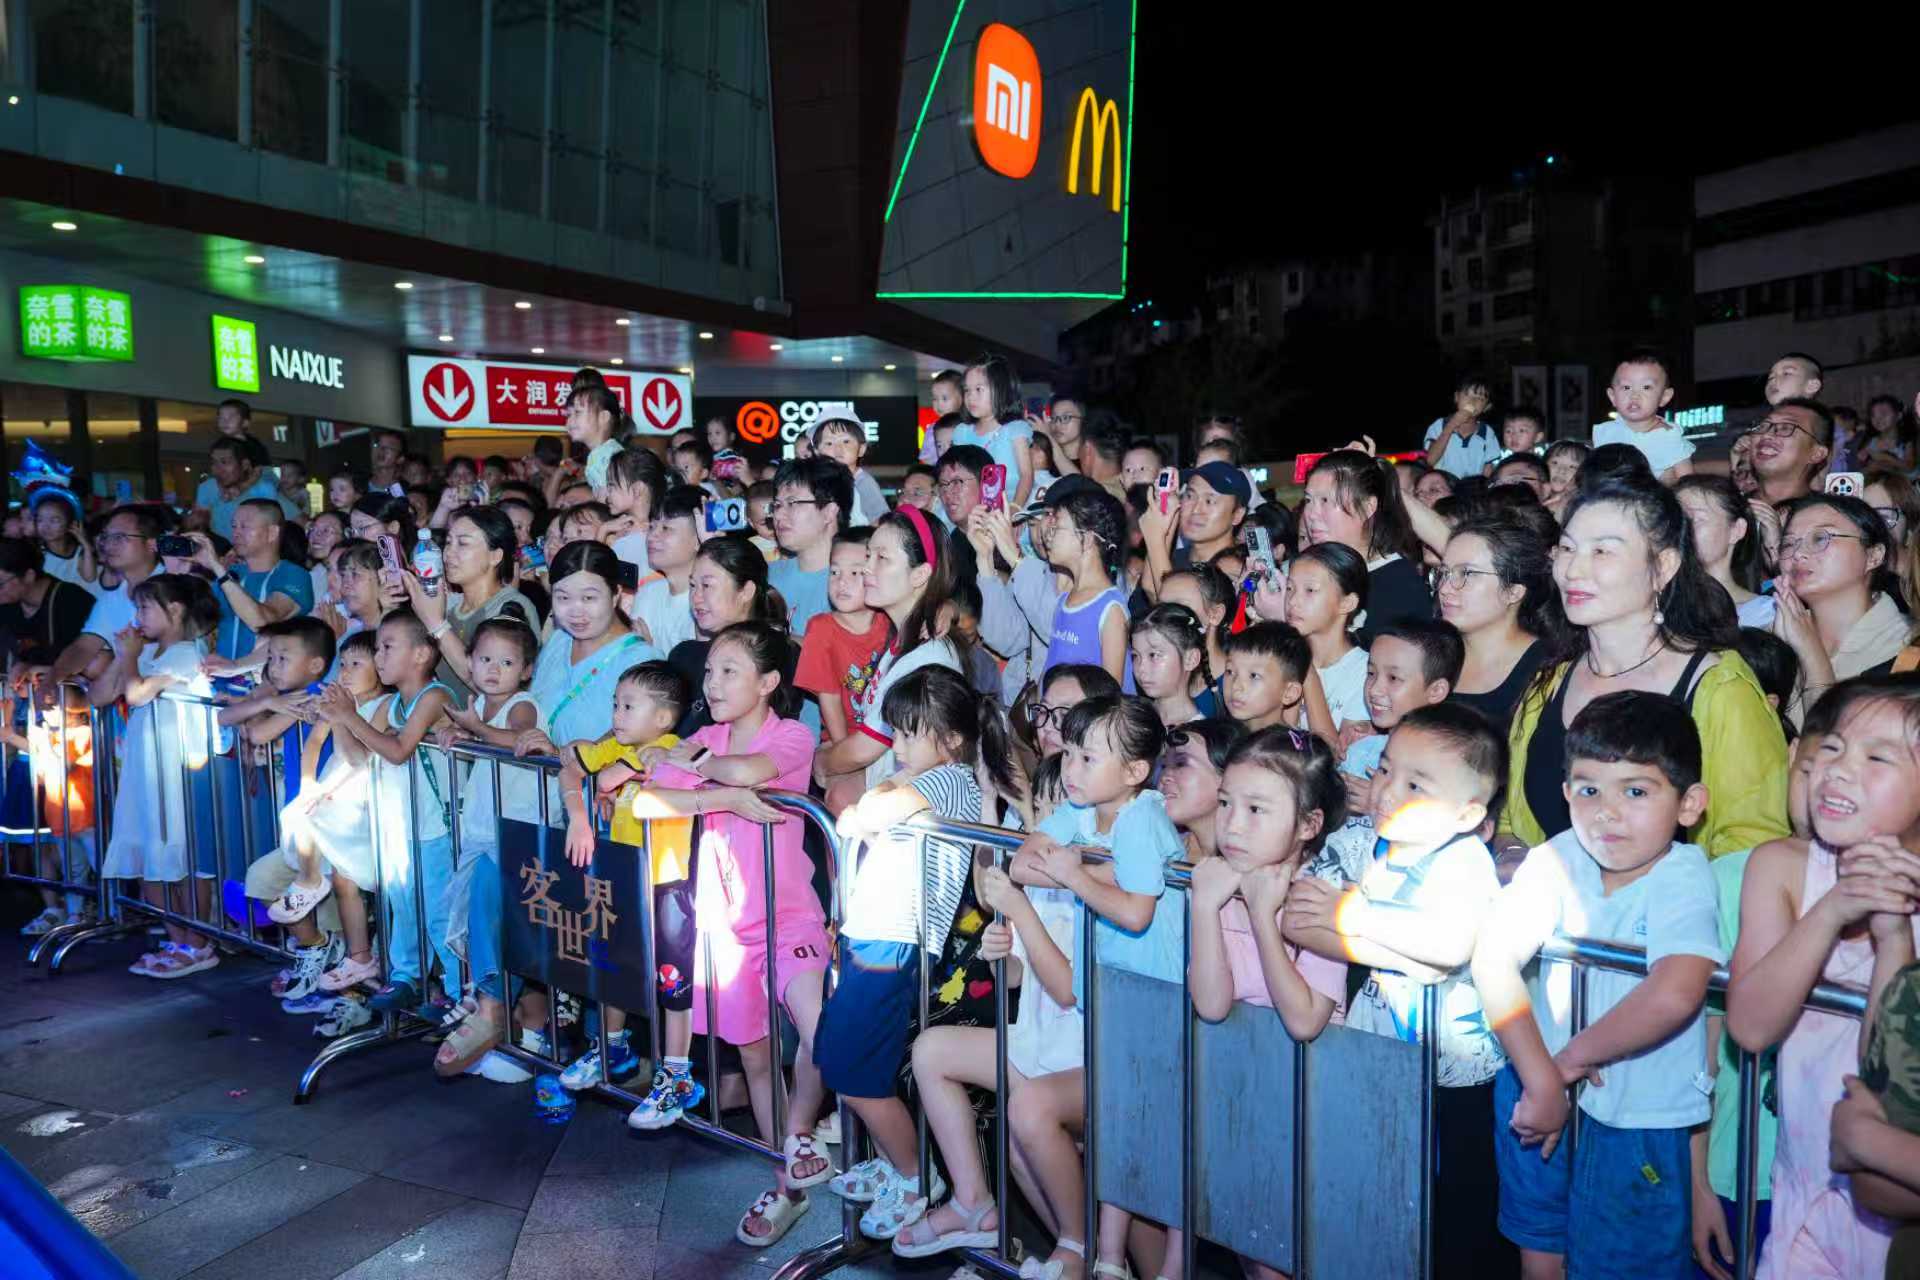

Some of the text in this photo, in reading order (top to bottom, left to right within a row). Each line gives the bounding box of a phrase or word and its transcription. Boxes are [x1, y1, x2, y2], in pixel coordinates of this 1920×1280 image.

[28, 321, 76, 347] 的茶
[85, 322, 129, 352] 的茶
[270, 344, 345, 389] NAIXUE
